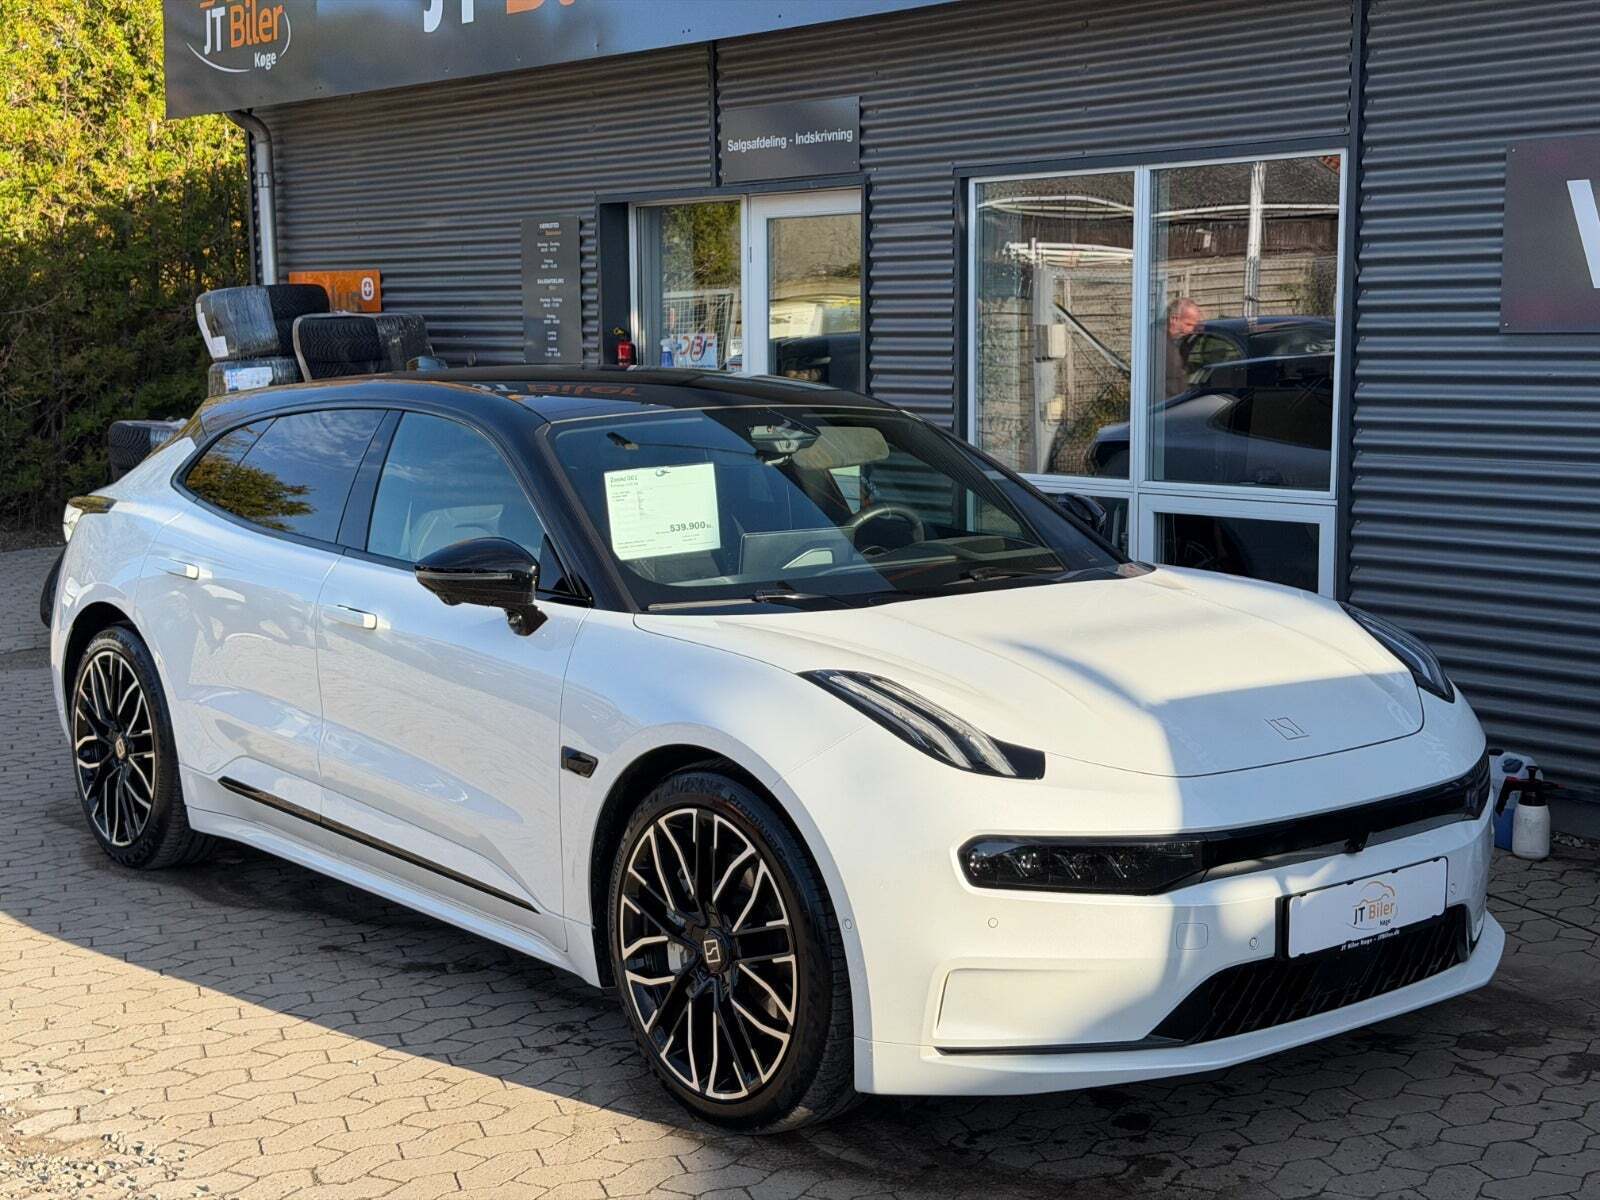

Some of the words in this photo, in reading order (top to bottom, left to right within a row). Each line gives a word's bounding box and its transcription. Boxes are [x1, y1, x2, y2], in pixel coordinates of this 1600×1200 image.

[204, 7, 225, 55] JT
[230, 0, 283, 48] Biler
[254, 51, 277, 70] Køge
[728, 136, 786, 152] Salgsafdeling
[795, 128, 853, 143] Indskrivning
[670, 521, 706, 532] 539.900
[1354, 906, 1365, 925] JT
[1369, 901, 1394, 920] Biler
